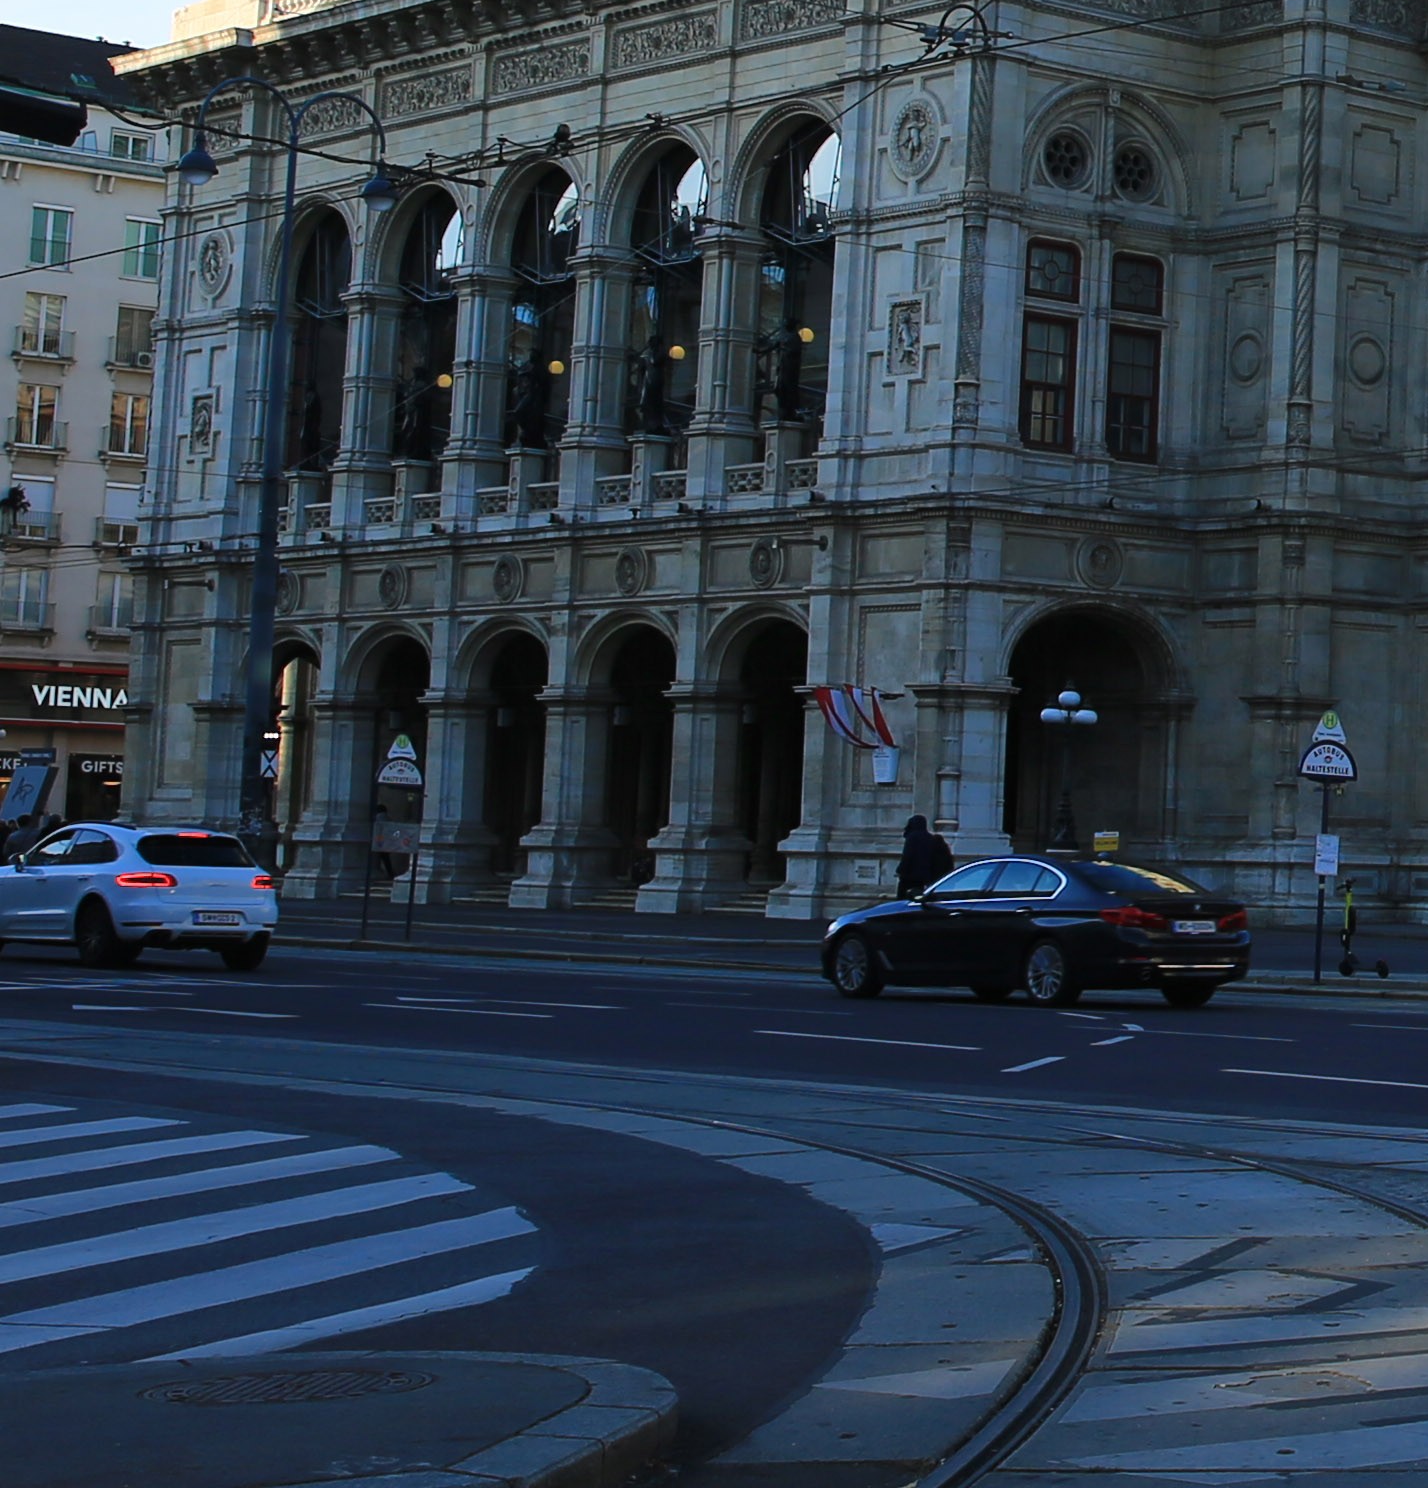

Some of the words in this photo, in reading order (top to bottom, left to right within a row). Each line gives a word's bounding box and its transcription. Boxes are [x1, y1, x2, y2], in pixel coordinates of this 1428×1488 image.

[32, 684, 128, 709] VIENNA
[1313, 746, 1345, 760] AUTOBUS
[81, 760, 123, 774] GIFTS
[1306, 765, 1349, 775] HALTESTELLE
